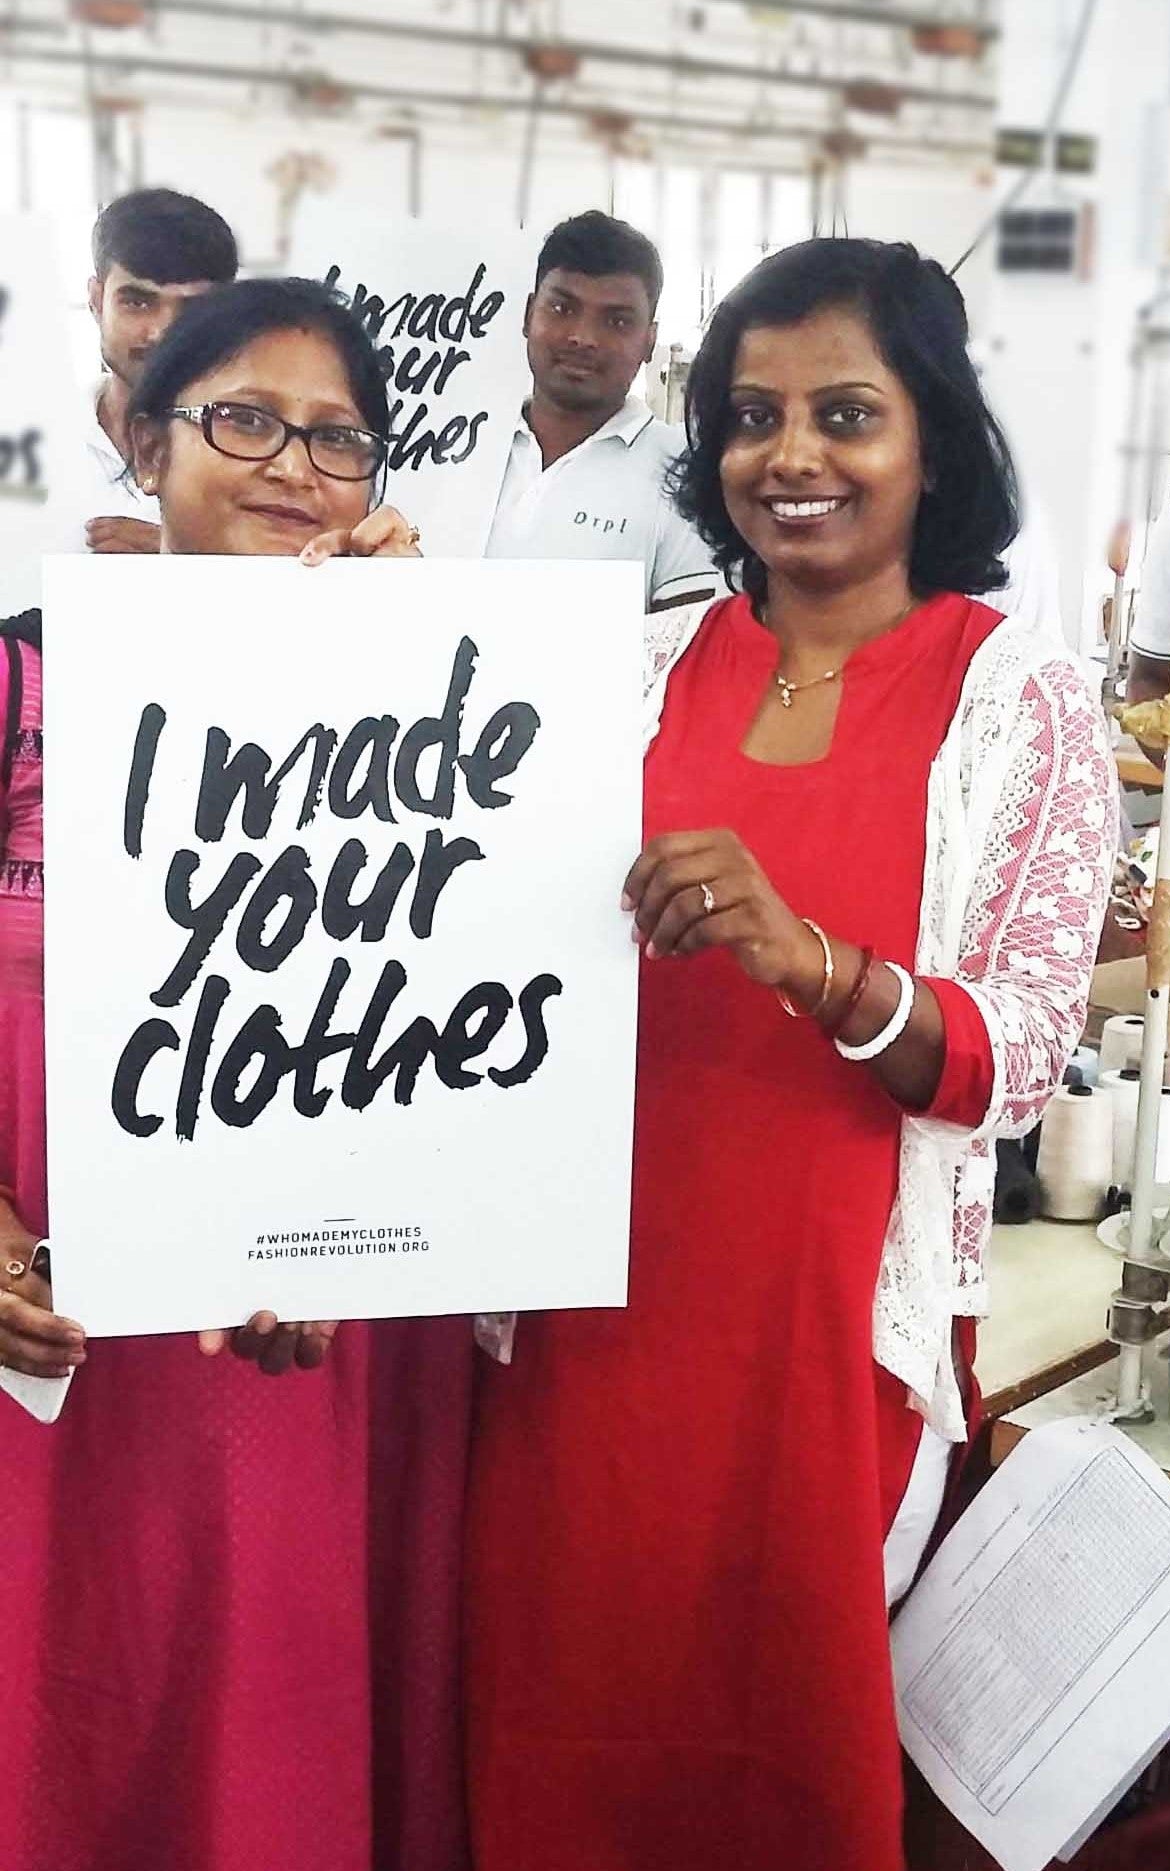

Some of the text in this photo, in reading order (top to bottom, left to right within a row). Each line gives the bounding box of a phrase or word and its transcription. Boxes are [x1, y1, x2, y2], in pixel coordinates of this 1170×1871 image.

[123, 635, 541, 858] I made
[150, 828, 486, 1008] your
[111, 957, 563, 1143] clothes
[256, 1226, 422, 1245] #WHOMADEMYCLOTHES
